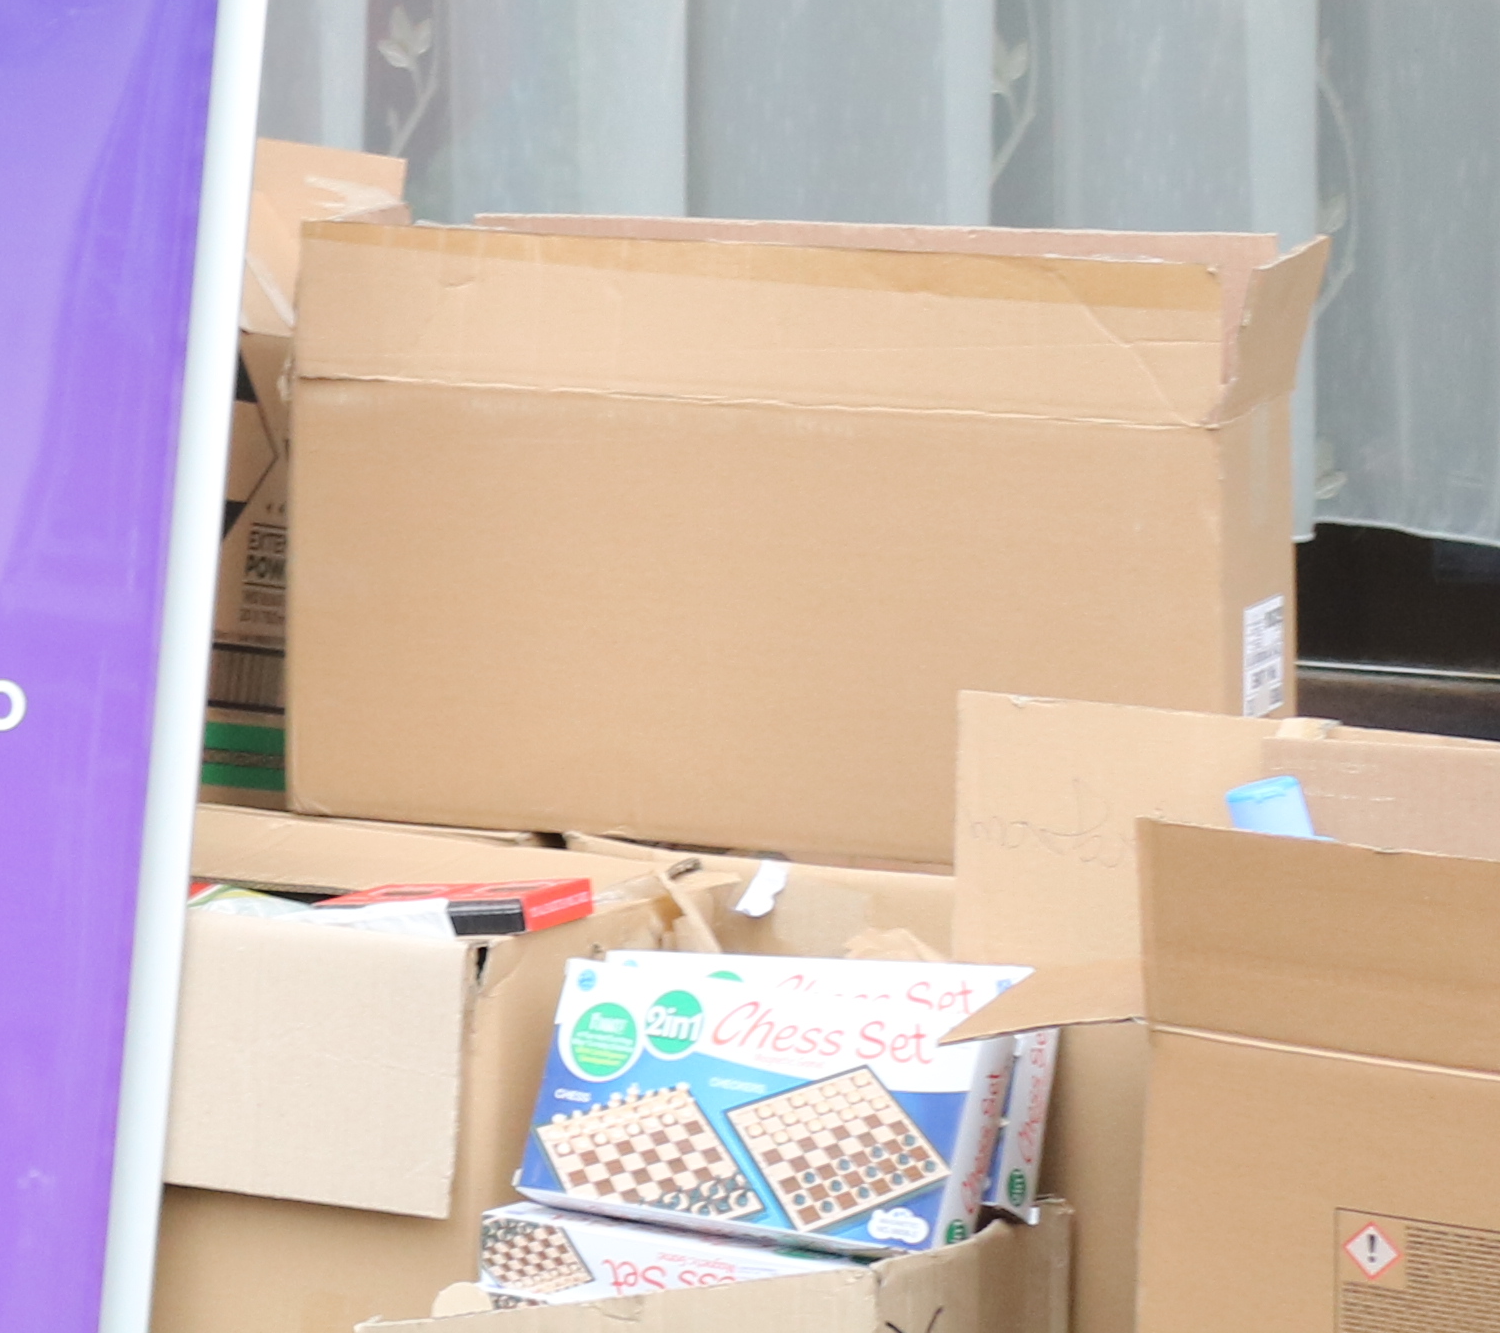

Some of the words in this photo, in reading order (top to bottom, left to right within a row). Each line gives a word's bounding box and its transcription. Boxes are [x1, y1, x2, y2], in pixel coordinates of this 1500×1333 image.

[711, 1000, 845, 1056] Chess
[855, 1020, 934, 1065] Set
[553, 1088, 592, 1103] CHESS
